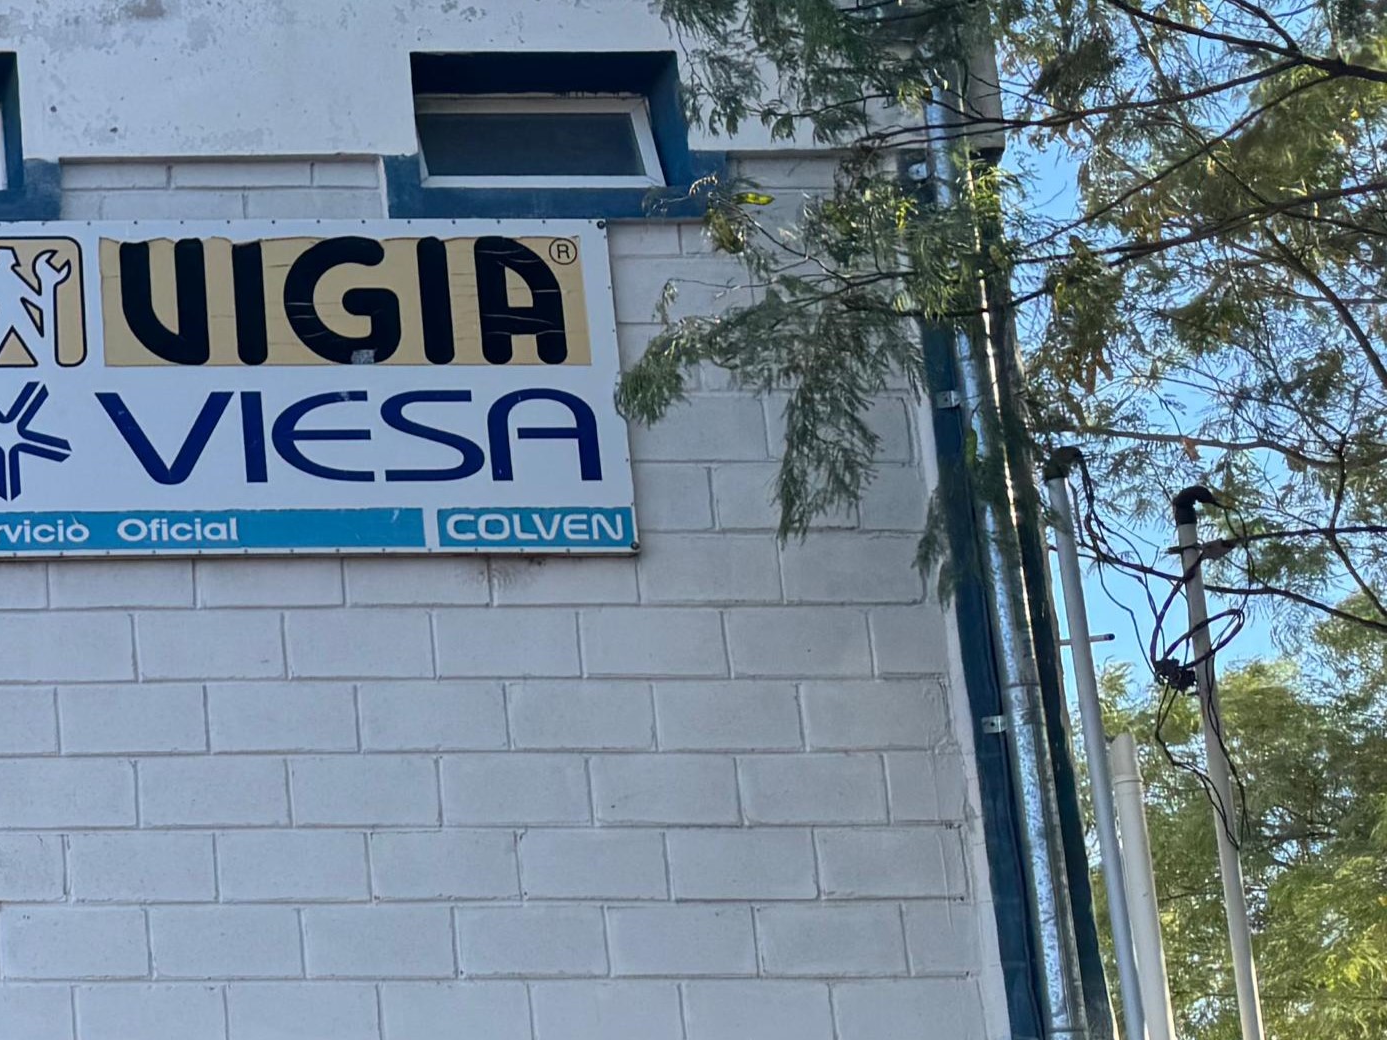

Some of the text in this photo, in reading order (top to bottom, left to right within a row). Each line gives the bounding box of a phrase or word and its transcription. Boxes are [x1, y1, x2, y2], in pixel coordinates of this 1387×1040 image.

[94, 387, 603, 485] VIESA
[117, 516, 239, 544] Oficial
[446, 513, 624, 543] COLVEN
